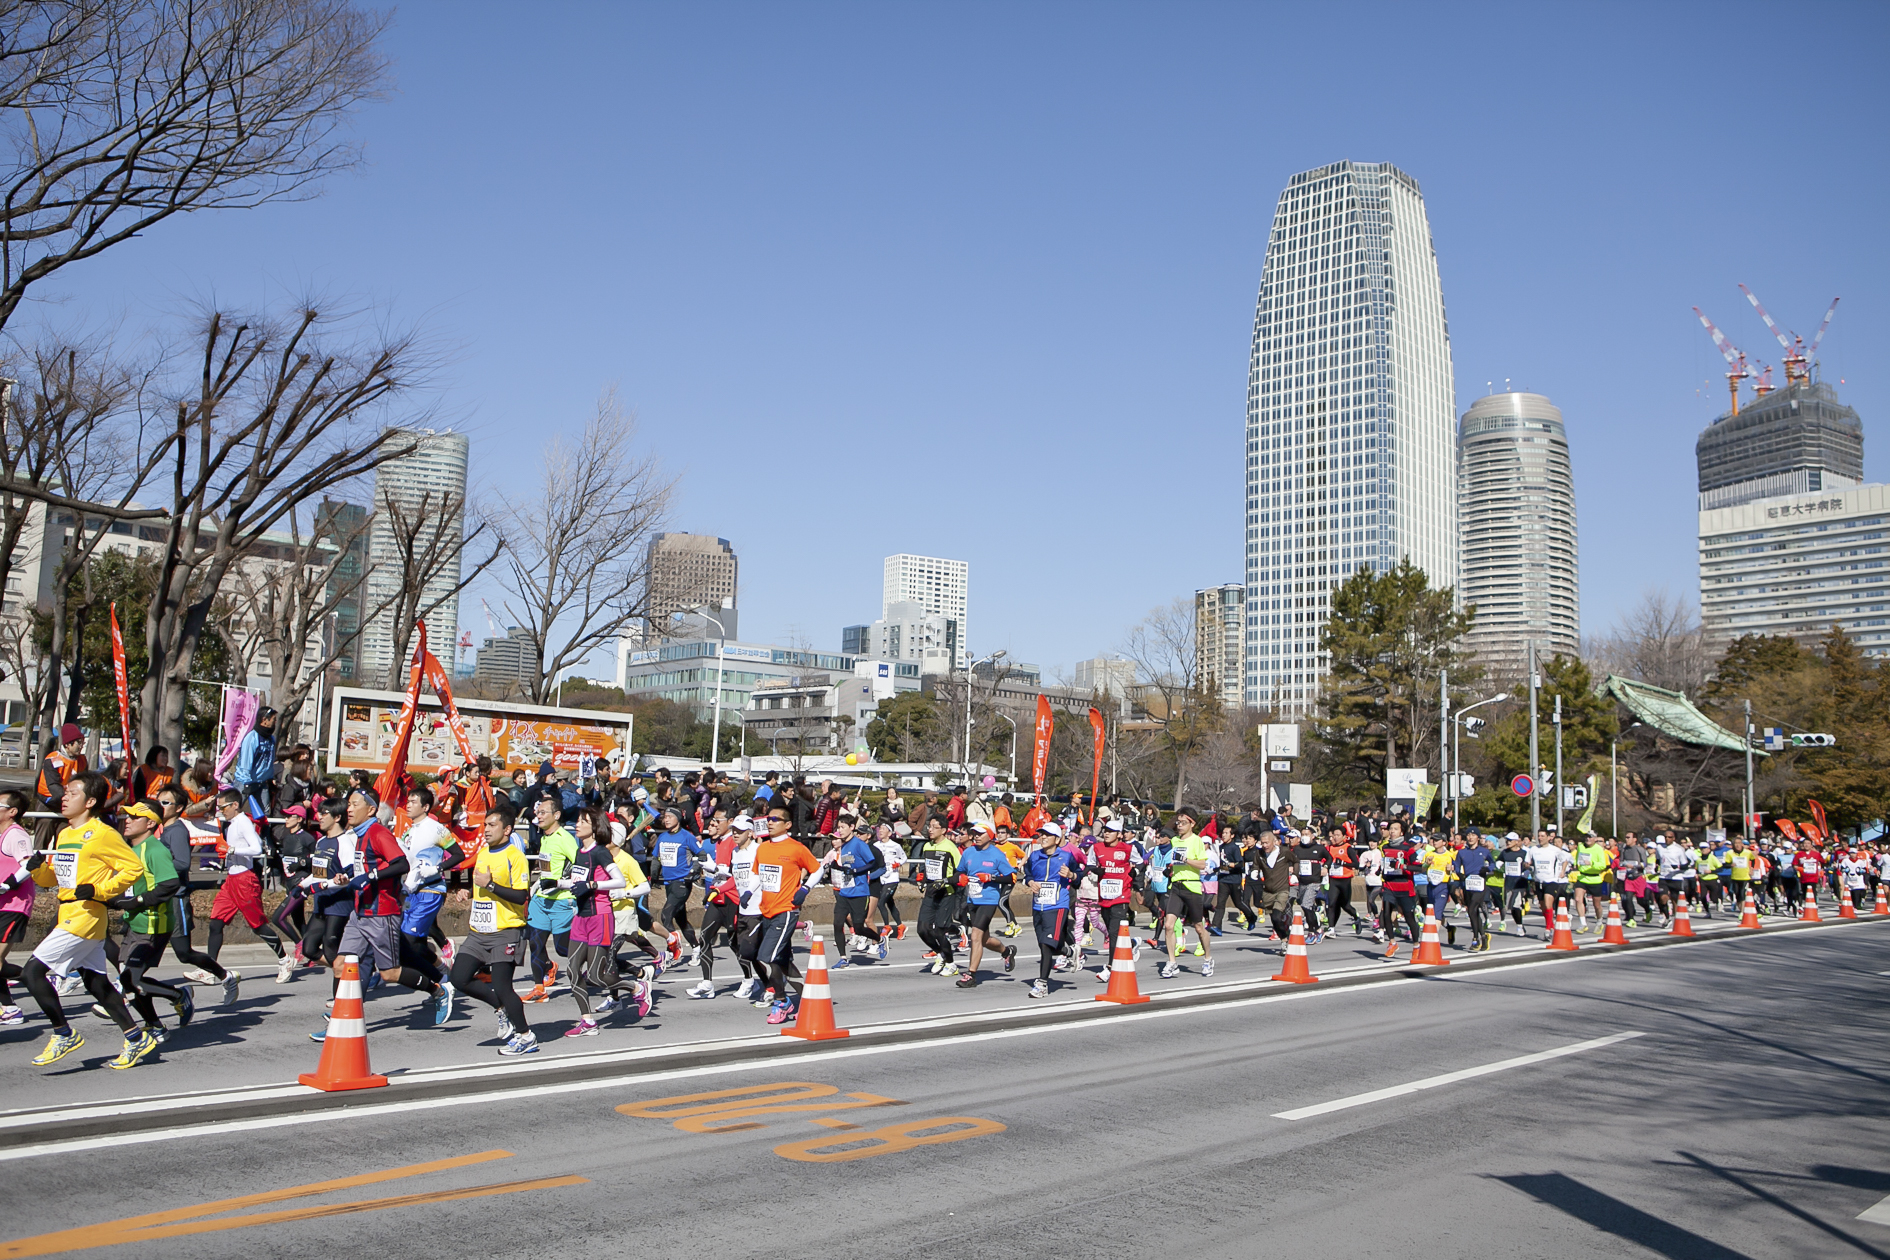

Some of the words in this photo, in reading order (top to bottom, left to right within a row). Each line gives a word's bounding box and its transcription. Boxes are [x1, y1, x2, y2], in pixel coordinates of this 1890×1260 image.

[542, 725, 578, 742] チャイナ
[1274, 744, 1281, 755] P
[1104, 866, 1125, 874] mirates
